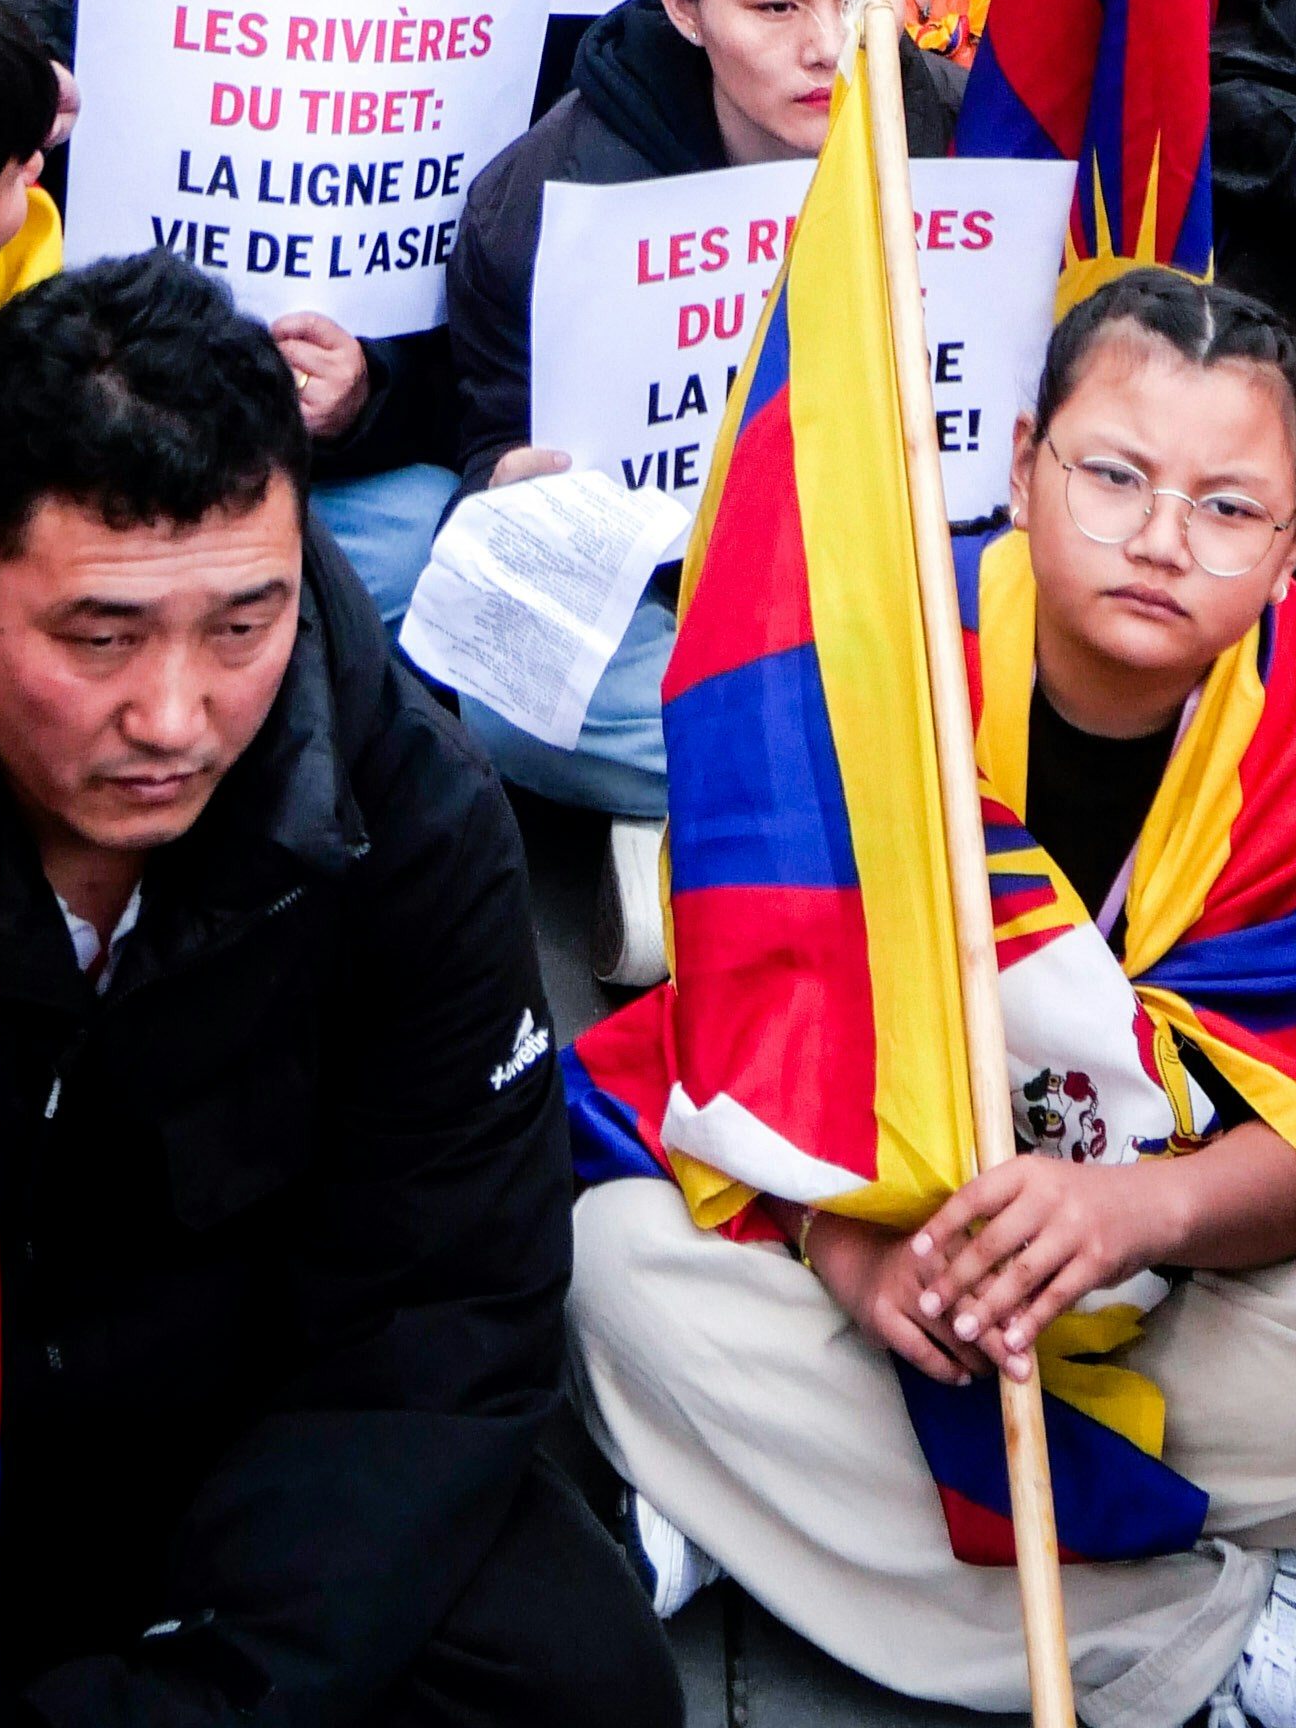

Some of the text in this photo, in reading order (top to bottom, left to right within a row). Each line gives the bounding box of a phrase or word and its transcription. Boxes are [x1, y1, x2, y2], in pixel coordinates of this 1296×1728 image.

[172, 6, 493, 65] LES RIVIÈRES
[210, 83, 443, 135] DU TIBET:
[177, 150, 465, 206] LA LIGNE DE
[151, 216, 230, 270] VIE
[246, 232, 314, 279] DE
[636, 227, 730, 287] LES
[677, 303, 744, 350] DU
[647, 379, 710, 427] LA
[621, 443, 700, 492] VIE
